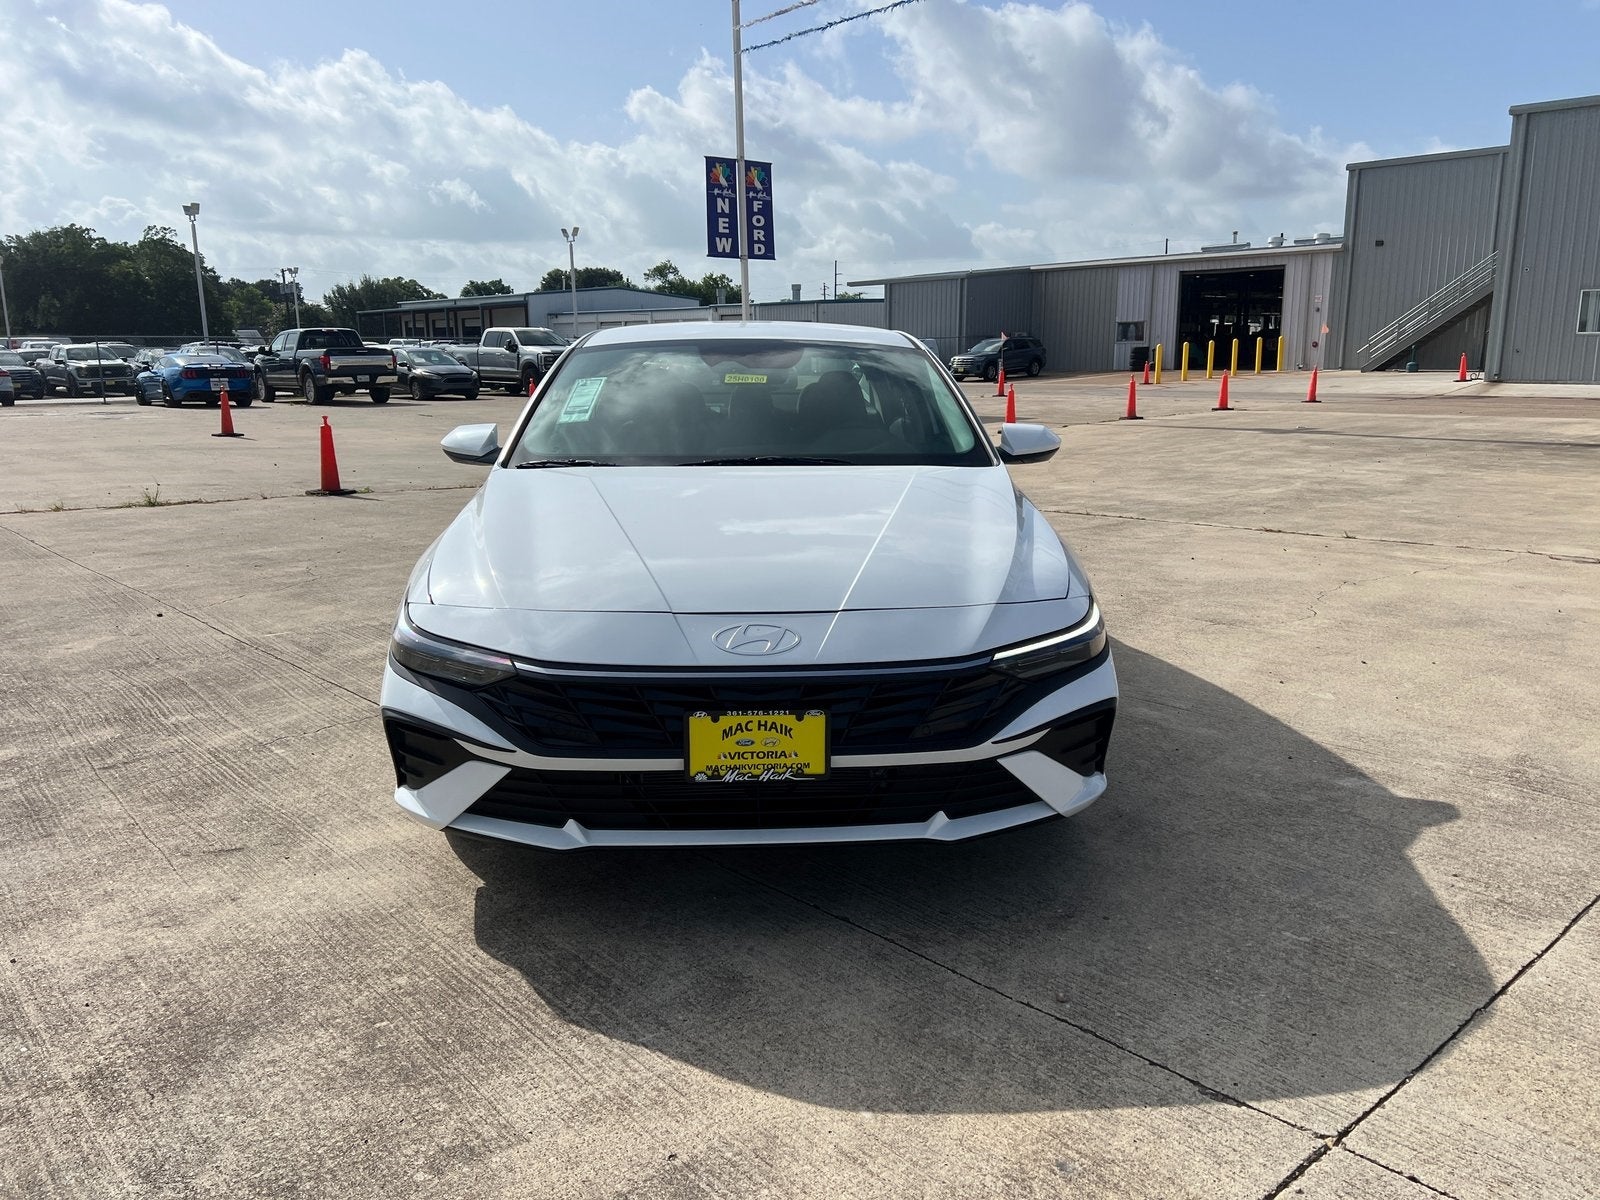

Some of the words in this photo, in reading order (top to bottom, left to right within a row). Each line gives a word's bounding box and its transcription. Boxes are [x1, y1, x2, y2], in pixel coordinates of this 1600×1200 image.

[715, 198, 732, 253] NEW
[751, 201, 766, 255] FORD
[721, 720, 753, 741] MAC
[757, 720, 793, 739] HAIK
[728, 750, 788, 761] VICTORIA
[705, 762, 811, 772] MACHAIKVICTORIA.COM
[721, 768, 757, 782] Mac
[759, 768, 796, 782] Haik
